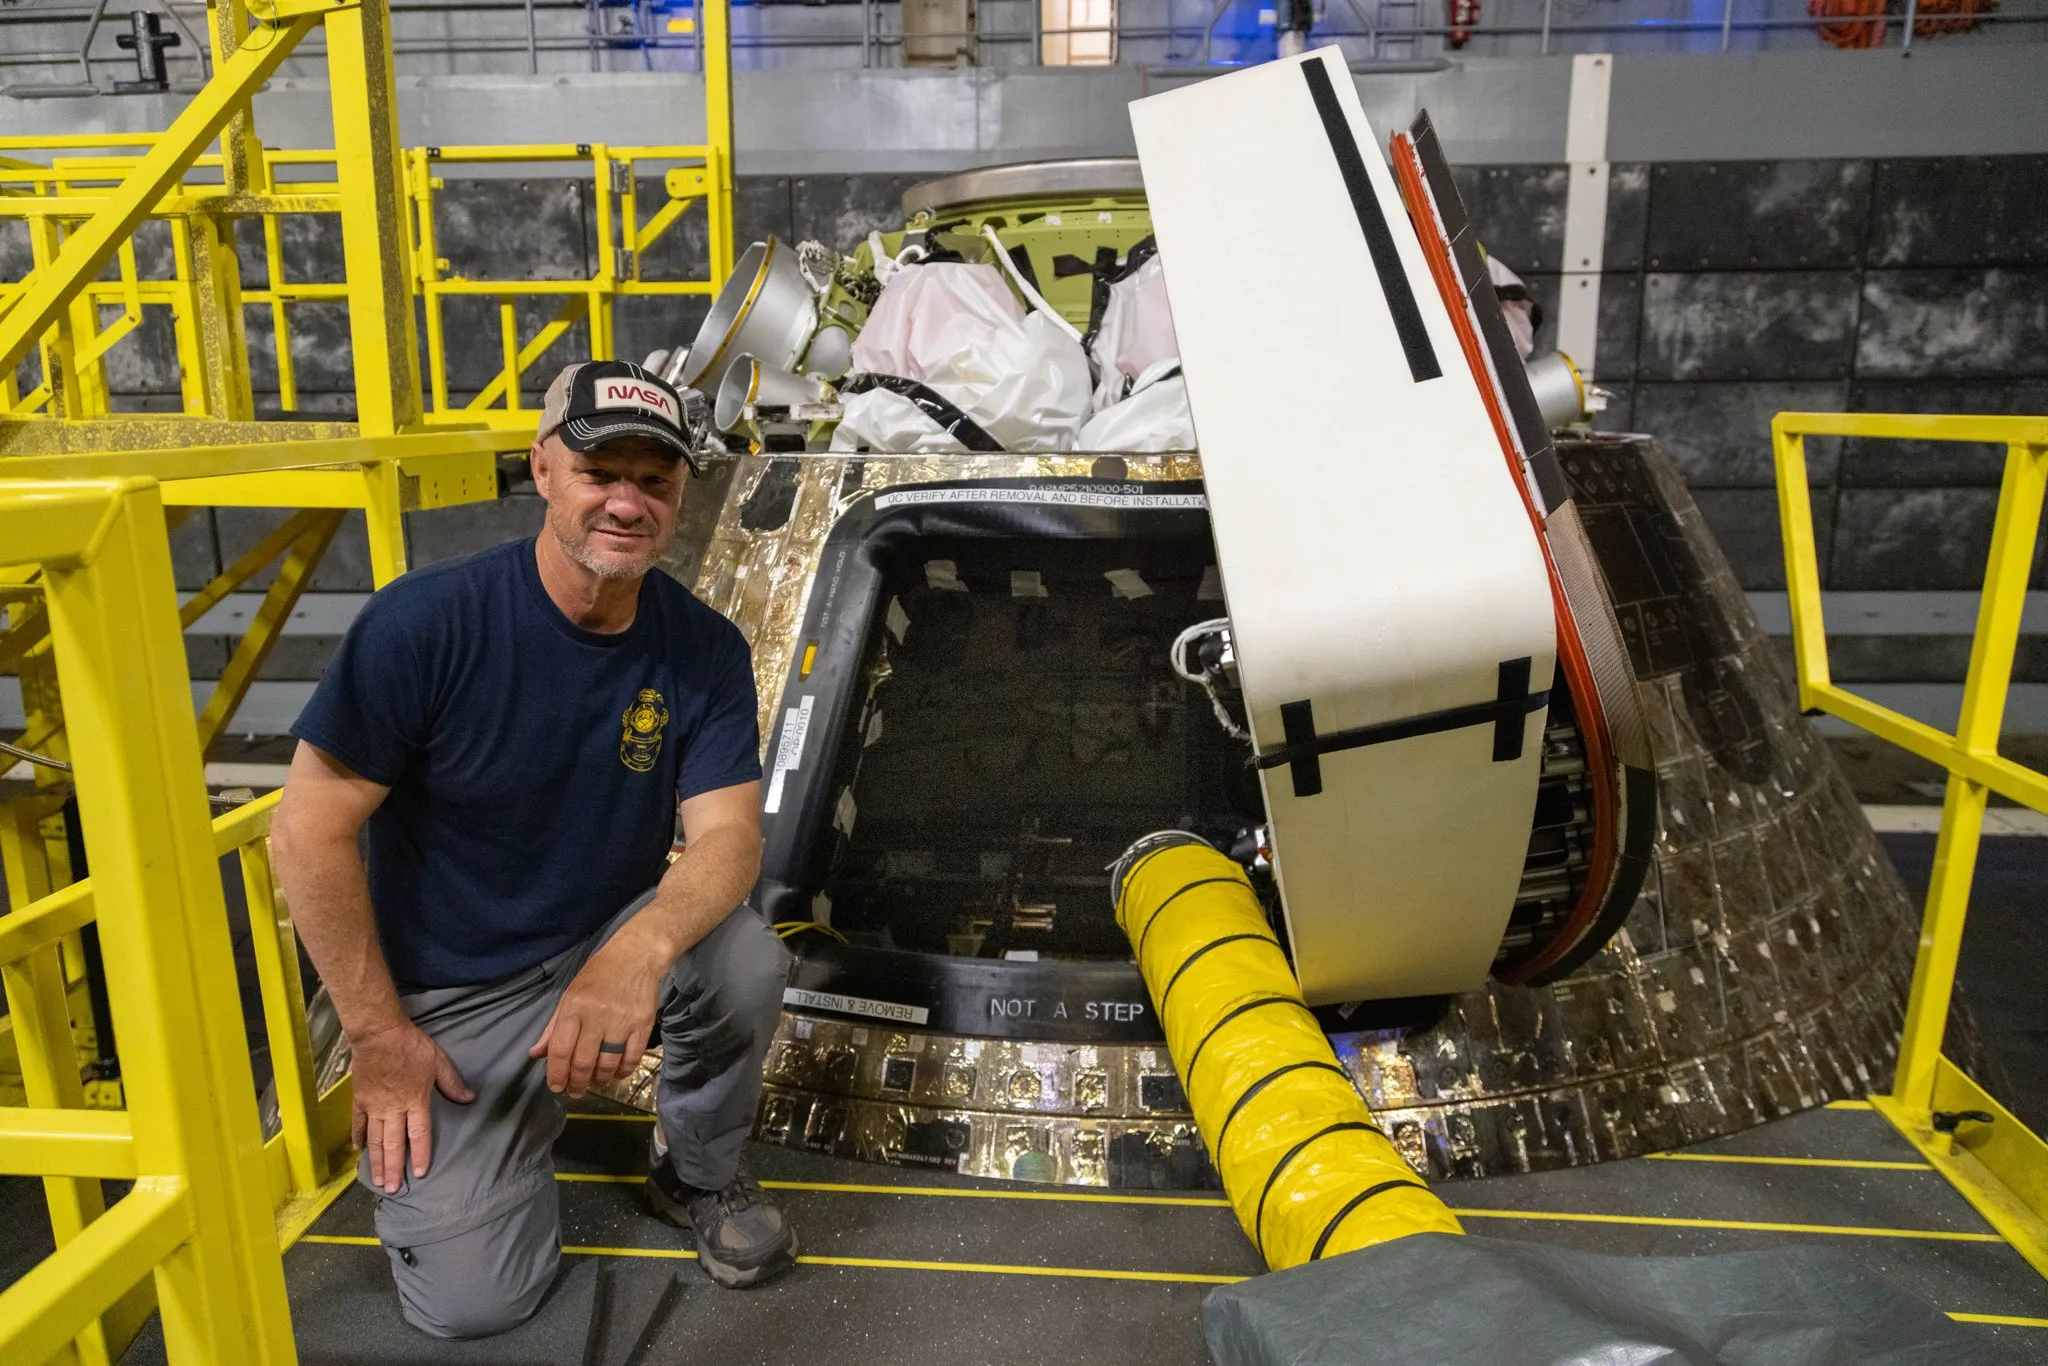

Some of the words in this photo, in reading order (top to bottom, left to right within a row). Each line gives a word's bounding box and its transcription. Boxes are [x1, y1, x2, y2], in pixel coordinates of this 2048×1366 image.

[608, 385, 672, 415] NASA
[888, 493, 903, 504] QC
[906, 491, 946, 502] VERIFY
[949, 490, 987, 500] AFTER
[990, 491, 1049, 502] REMOVAL
[1050, 492, 1077, 502] AND
[1080, 494, 1129, 506] BEFORE
[776, 722, 794, 772] 10895711
[795, 991, 843, 1009] INSTALL
[847, 1000, 856, 1011] &
[858, 1001, 914, 1019] REMOVE
[990, 998, 1036, 1017] NOT
[1053, 1002, 1068, 1019] A
[1085, 1001, 1144, 1022] STEP
